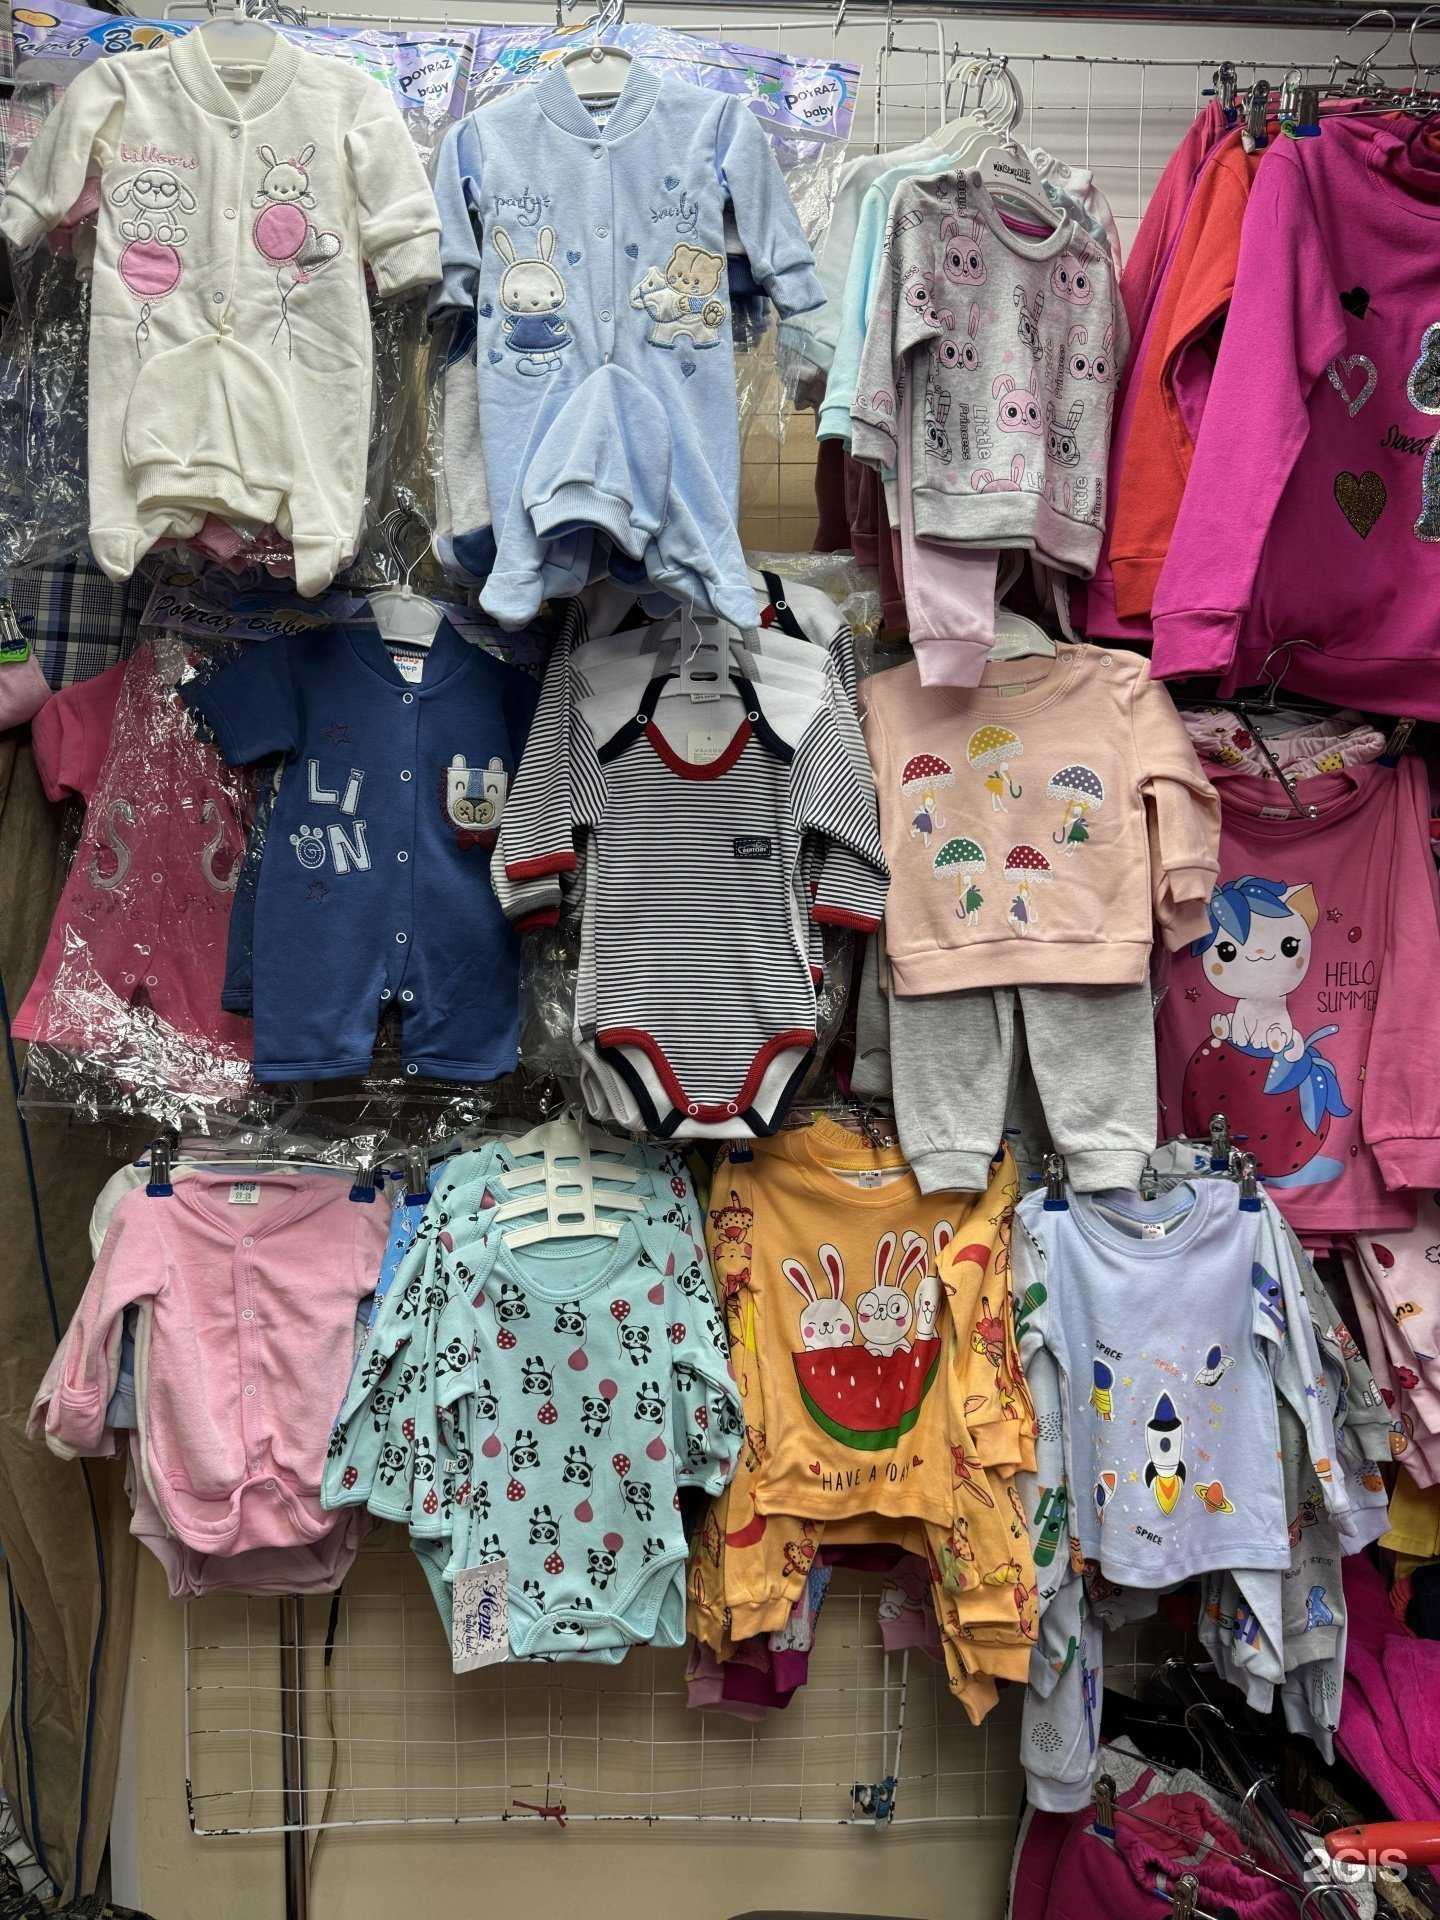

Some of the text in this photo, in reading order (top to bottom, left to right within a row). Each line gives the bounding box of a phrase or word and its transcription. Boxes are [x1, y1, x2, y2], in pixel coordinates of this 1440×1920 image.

[399, 60, 453, 93] POYRAZ
[417, 81, 449, 98] baby
[784, 80, 838, 110] POYRAZ
[803, 105, 834, 118] baby
[959, 403, 971, 461] Princess
[972, 403, 993, 460] Little
[1325, 960, 1375, 987] HELLO
[822, 1468, 860, 1491] HAVE
[868, 1464, 877, 1482] A
[1135, 1525, 1163, 1546] SPACE
[465, 1614, 473, 1634] baby
